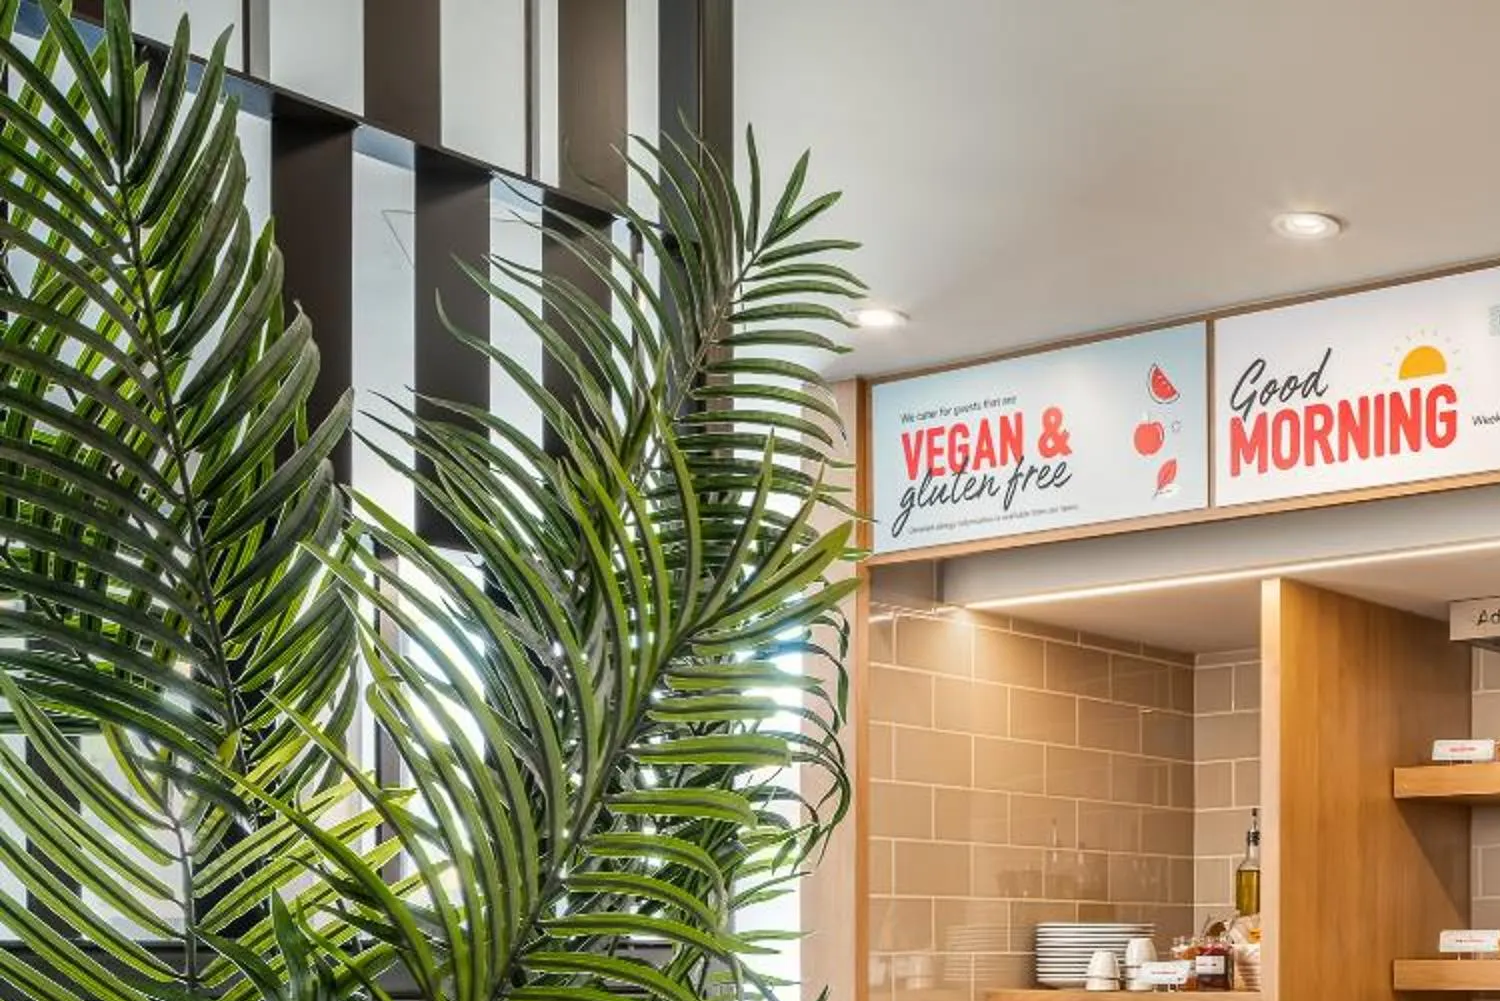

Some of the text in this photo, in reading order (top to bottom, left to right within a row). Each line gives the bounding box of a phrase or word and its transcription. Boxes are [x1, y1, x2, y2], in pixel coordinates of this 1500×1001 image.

[1230, 348, 1332, 422] Good
[901, 406, 1072, 480] VEGAN &
[1230, 383, 1458, 477] MORNING
[892, 455, 1000, 537] gluten
[1004, 456, 1071, 510] free
